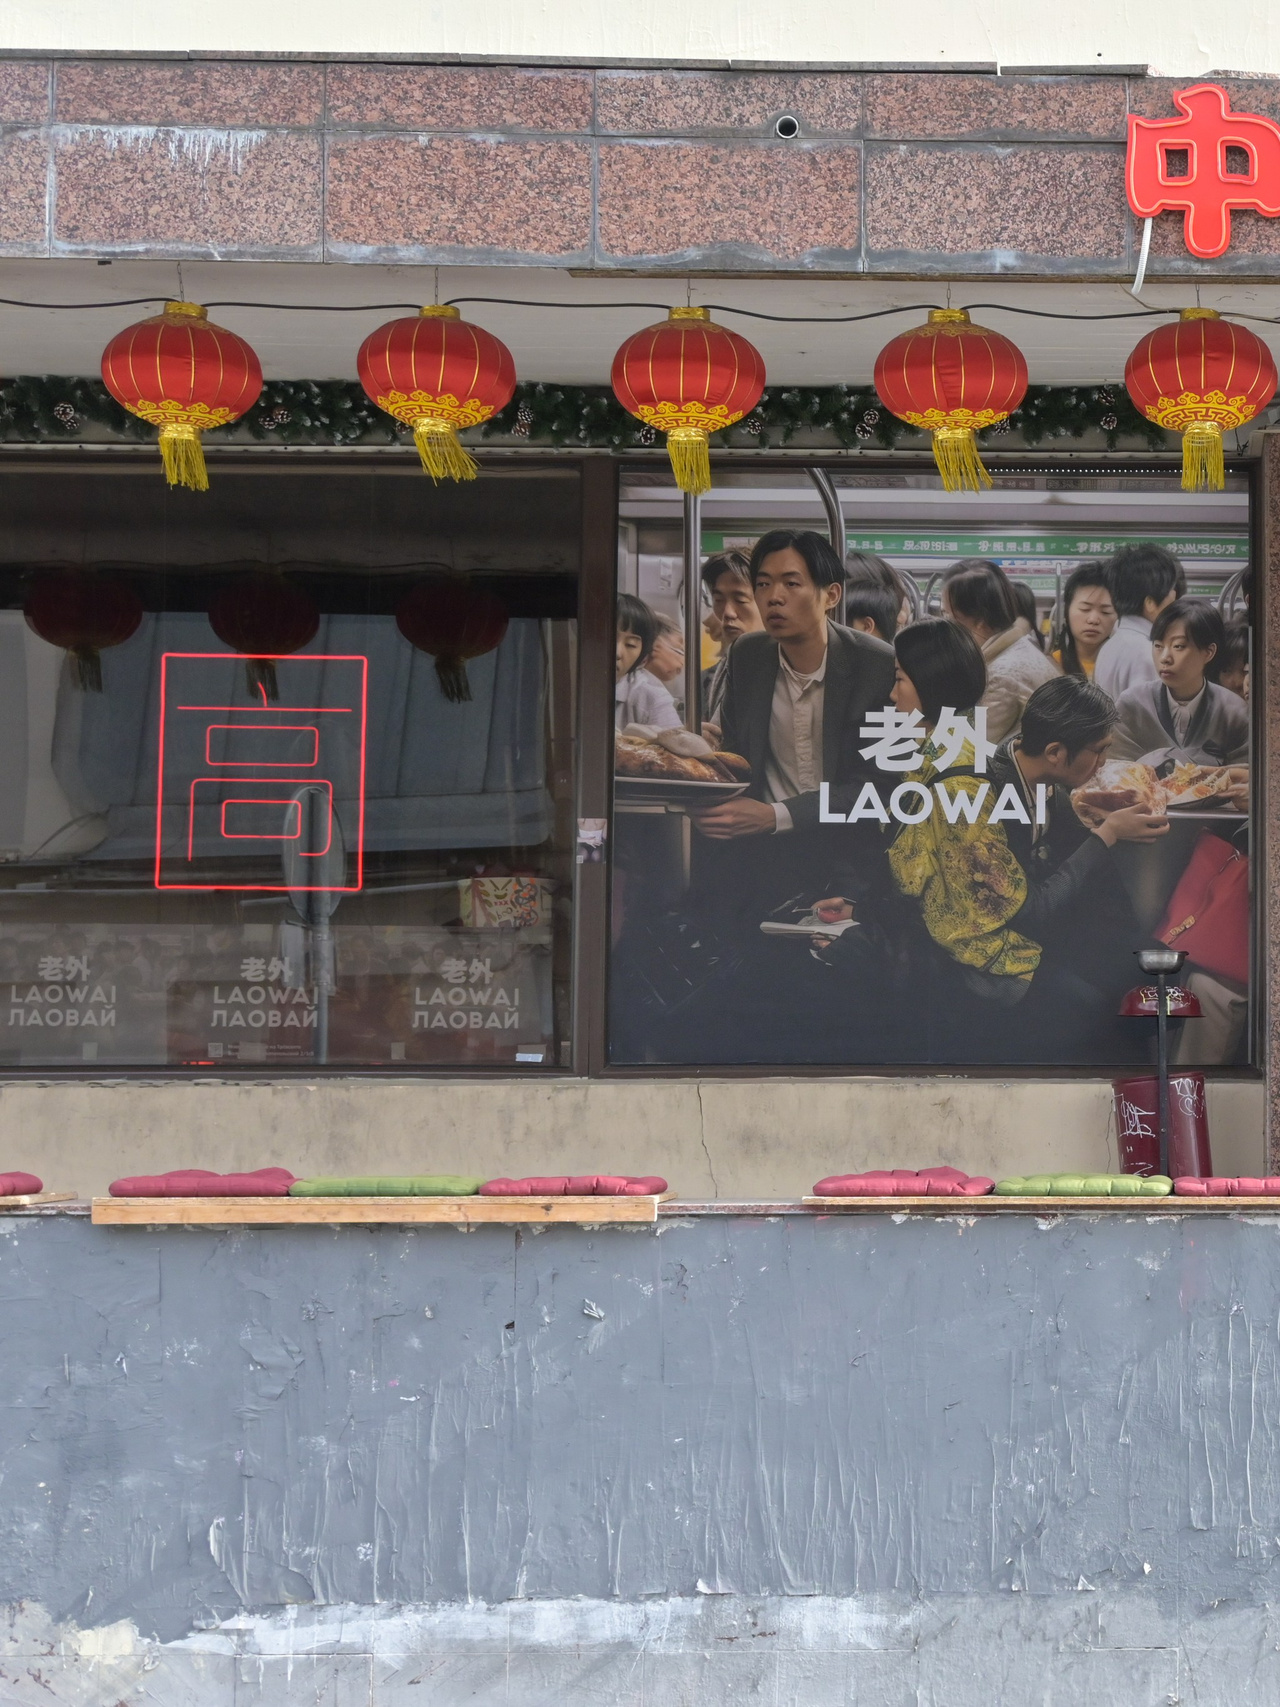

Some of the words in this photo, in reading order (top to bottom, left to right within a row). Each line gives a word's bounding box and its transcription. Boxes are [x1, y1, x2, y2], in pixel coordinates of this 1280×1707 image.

[858, 706, 998, 774] 老外
[819, 782, 1046, 825] LAOWAI
[38, 955, 90, 981] 老外
[240, 956, 293, 982] 老外
[441, 958, 494, 984] 老外
[11, 985, 117, 1004] LAOWAI
[213, 986, 319, 1005] LAOWAI
[415, 988, 519, 1006] LAOWAI
[8, 1005, 116, 1027] ЛАОВАЙ
[211, 1006, 318, 1028] ЛАОВАЙ
[412, 1007, 519, 1029] ЛАОВАЙ
